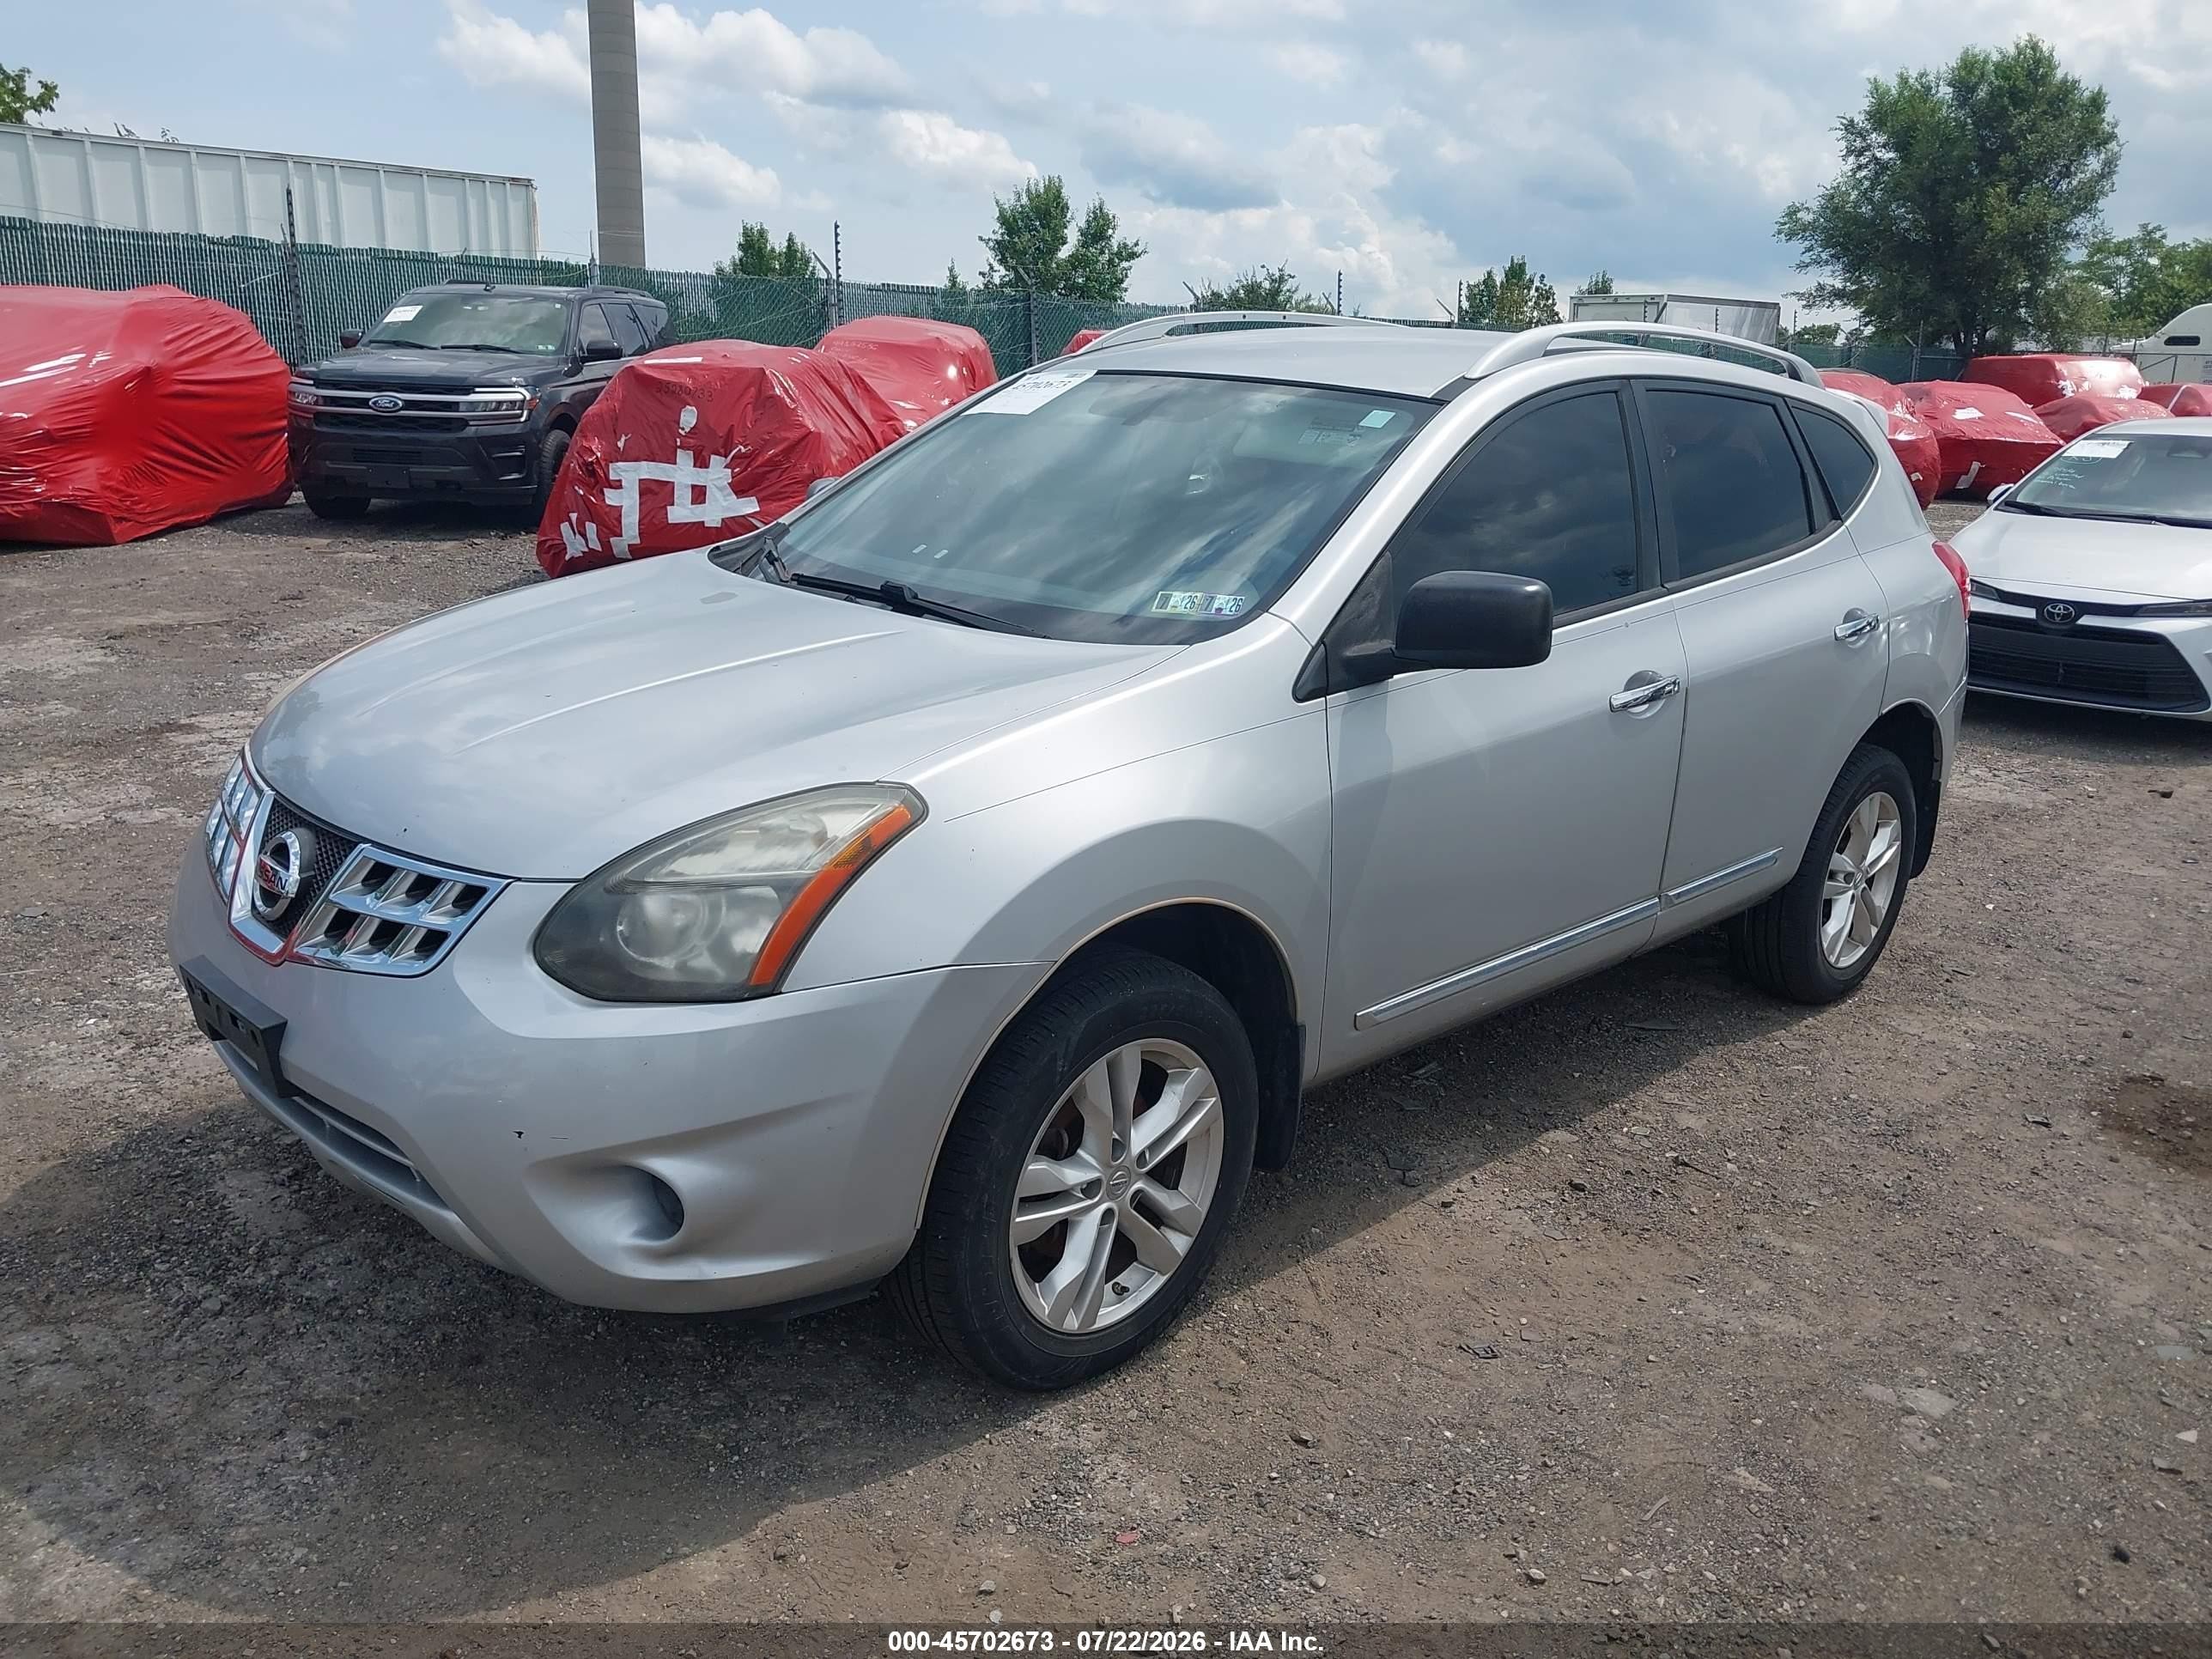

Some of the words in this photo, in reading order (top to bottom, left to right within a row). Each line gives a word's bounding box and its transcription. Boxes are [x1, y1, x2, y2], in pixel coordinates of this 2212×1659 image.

[1183, 595, 1199, 610] 26
[1204, 596, 1215, 611] 7
[1229, 598, 1243, 613] 26
